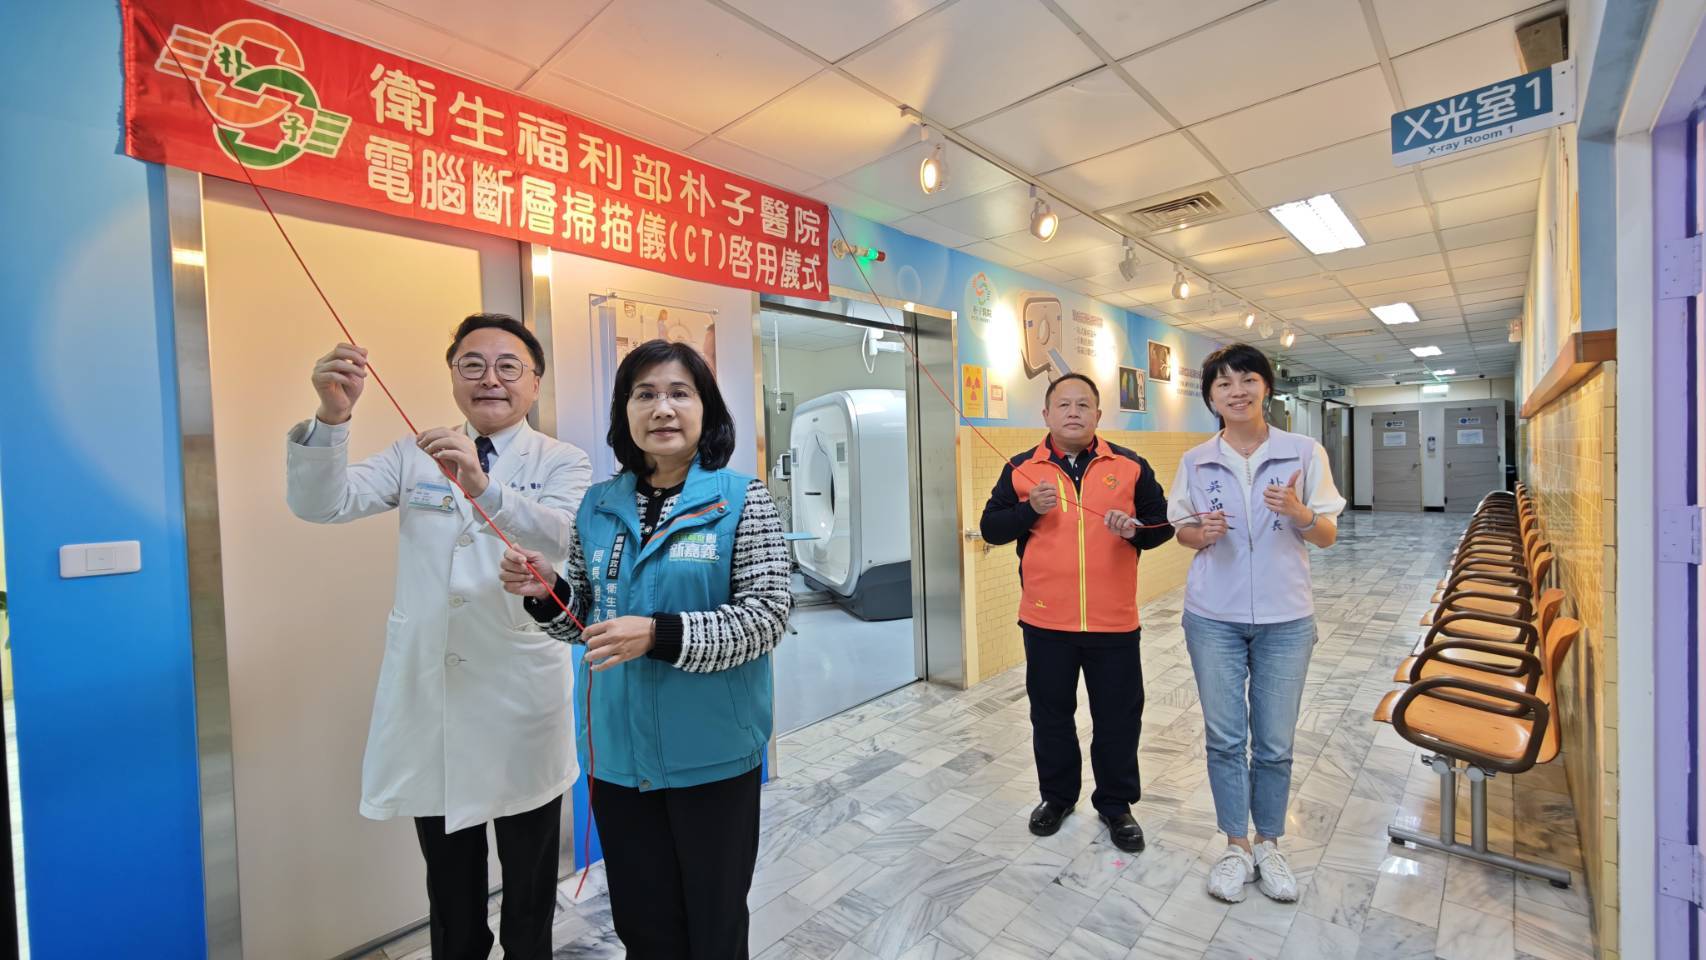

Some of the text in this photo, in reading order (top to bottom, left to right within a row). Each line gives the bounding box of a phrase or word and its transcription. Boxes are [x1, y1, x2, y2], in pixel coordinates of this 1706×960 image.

[281, 114, 305, 142] 子
[1428, 125, 1514, 155] X-ray Room 1
[368, 64, 821, 246] 衛生福利部朴子醫院
